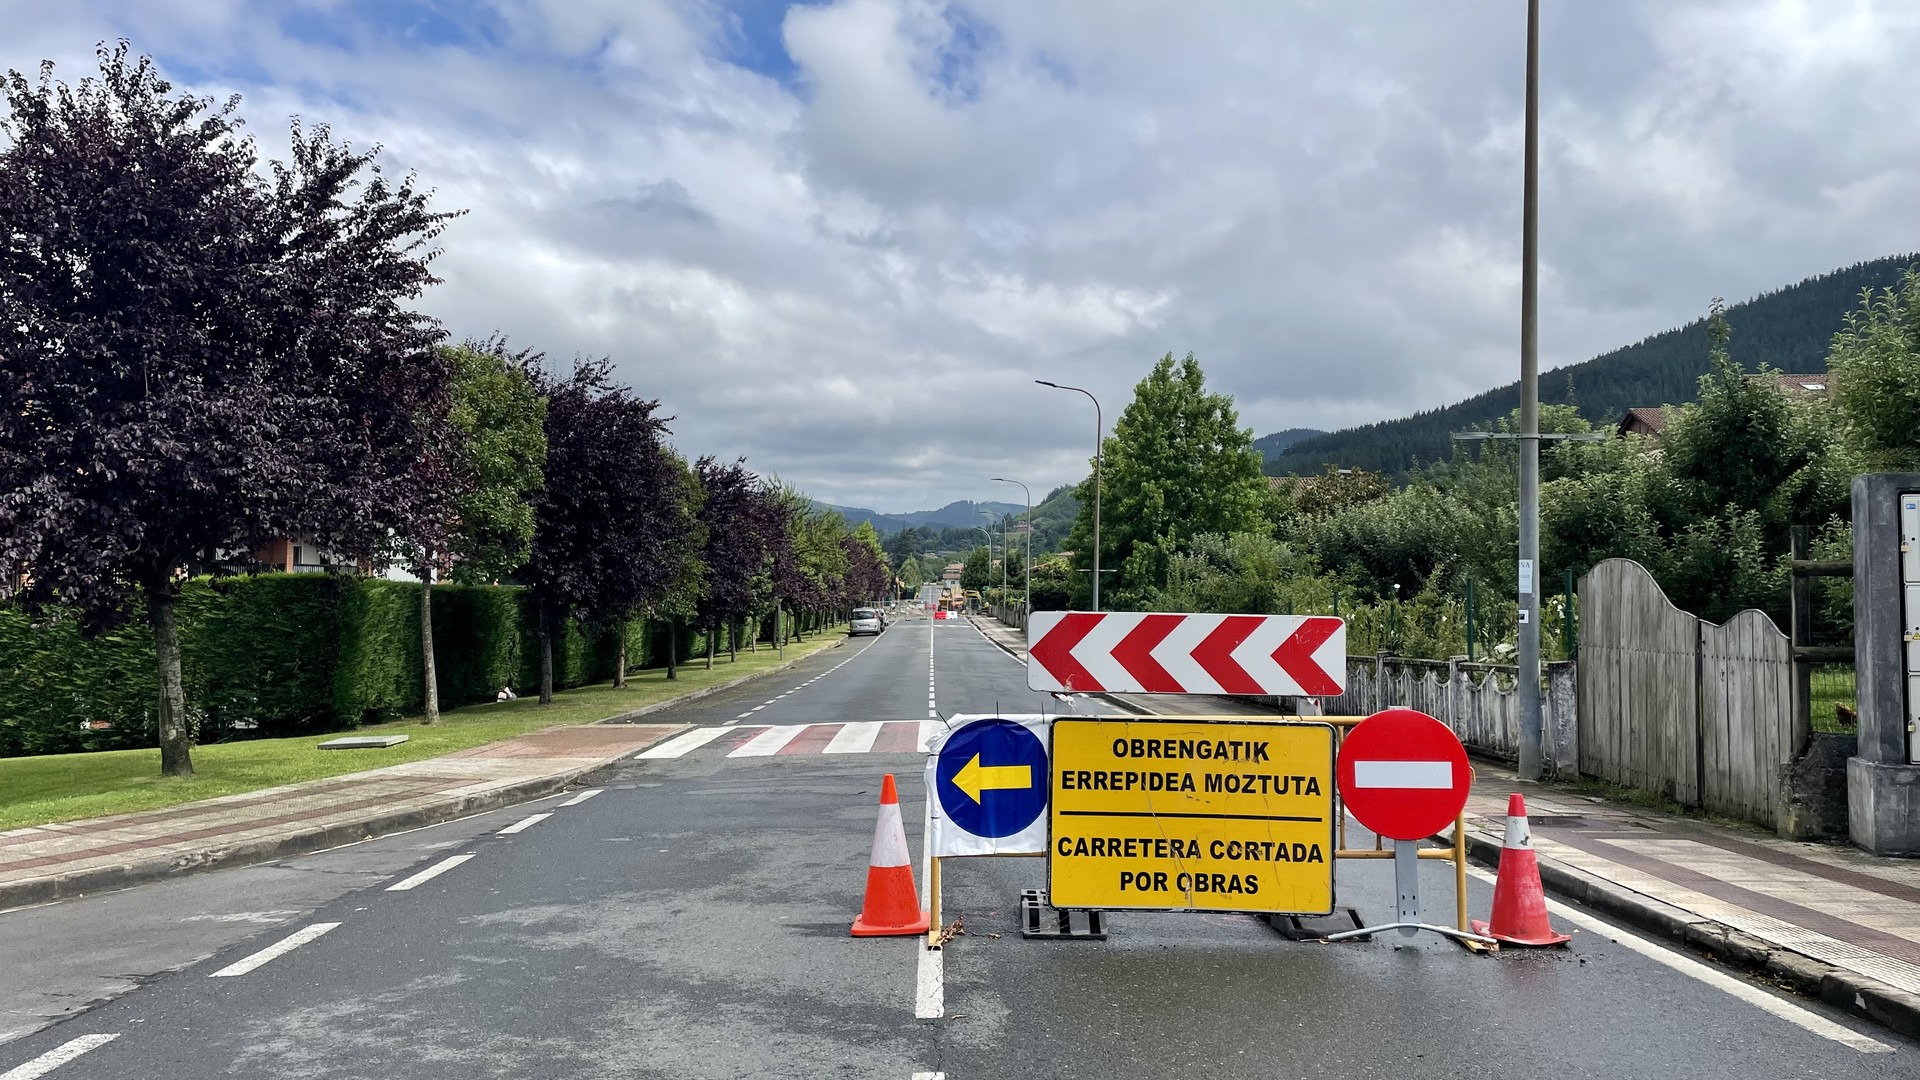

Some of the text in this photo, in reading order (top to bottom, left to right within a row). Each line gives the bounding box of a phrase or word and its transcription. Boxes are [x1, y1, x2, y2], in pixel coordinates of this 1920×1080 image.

[1113, 739, 1269, 761] OBRENGATIK
[1062, 770, 1321, 795] ERREPIDEA MOZTUTA
[1058, 837, 1324, 862] CARRETERA CORTADA
[1121, 872, 1259, 894] POR OBRAS
